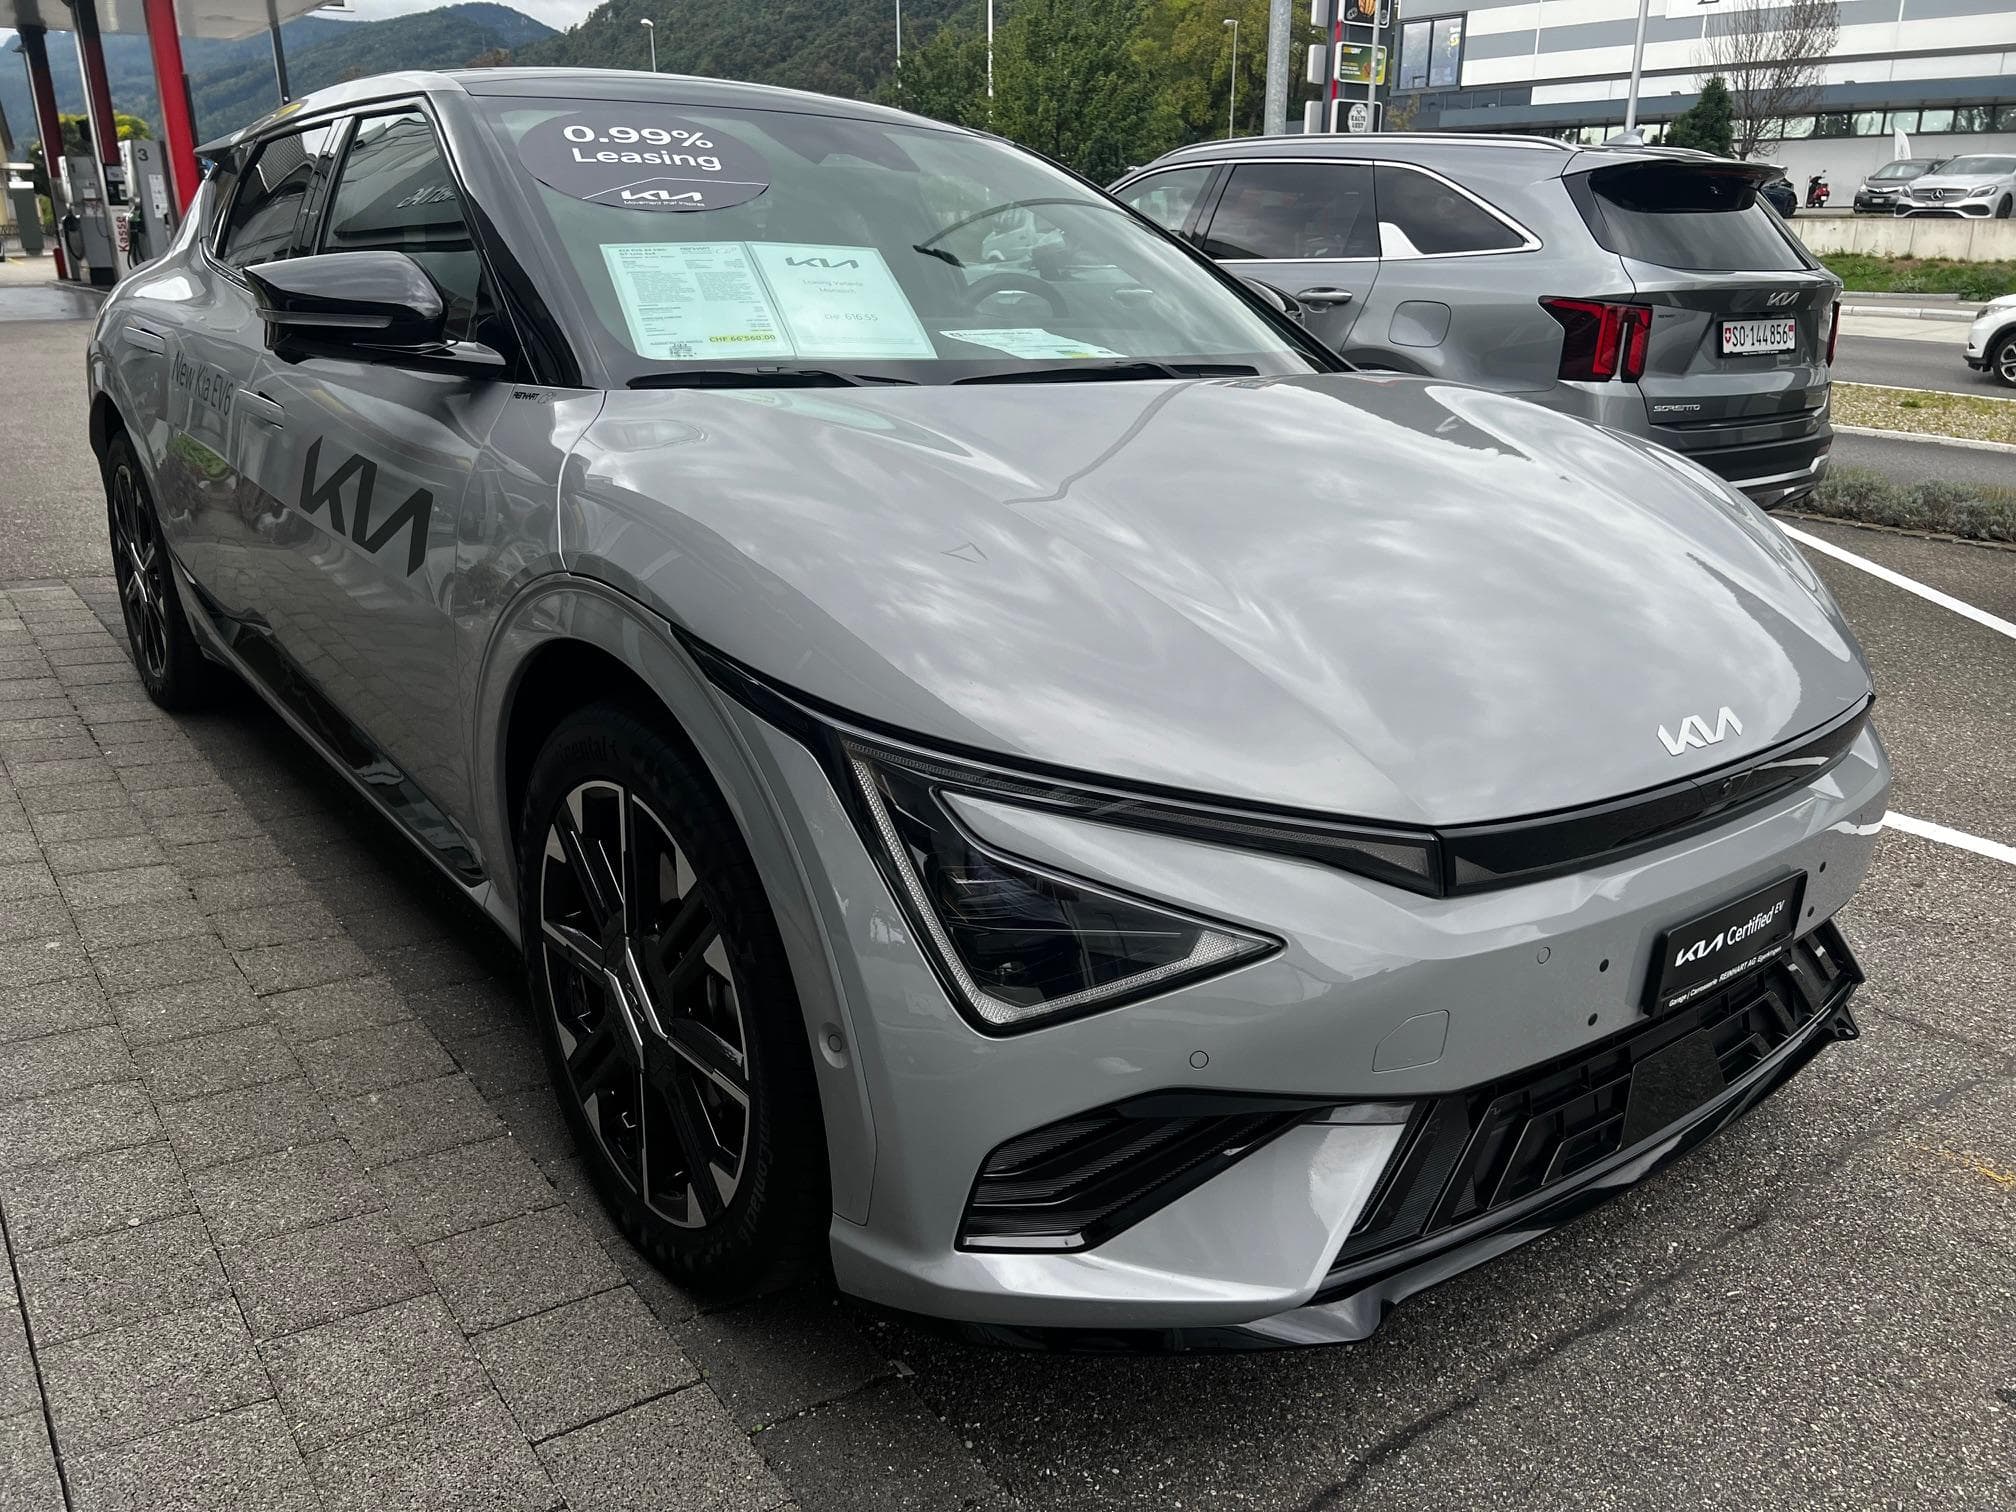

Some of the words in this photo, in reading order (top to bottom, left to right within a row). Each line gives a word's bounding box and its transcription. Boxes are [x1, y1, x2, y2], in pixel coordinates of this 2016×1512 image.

[563, 125, 714, 149] 0.99%
[137, 148, 149, 162] 3
[571, 148, 722, 171] Leasing
[620, 189, 703, 202] KIA
[785, 257, 860, 269] KIA
[1766, 291, 1800, 306] KIA
[709, 335, 728, 343] CHF
[171, 351, 195, 389] New
[194, 362, 211, 400] Kia
[210, 374, 235, 416] EV6
[300, 435, 434, 577] KIA
[1656, 706, 1744, 755] KIA
[1675, 932, 1725, 967] KIA
[1727, 905, 1775, 945] Certified
[1774, 900, 1786, 914] EV
